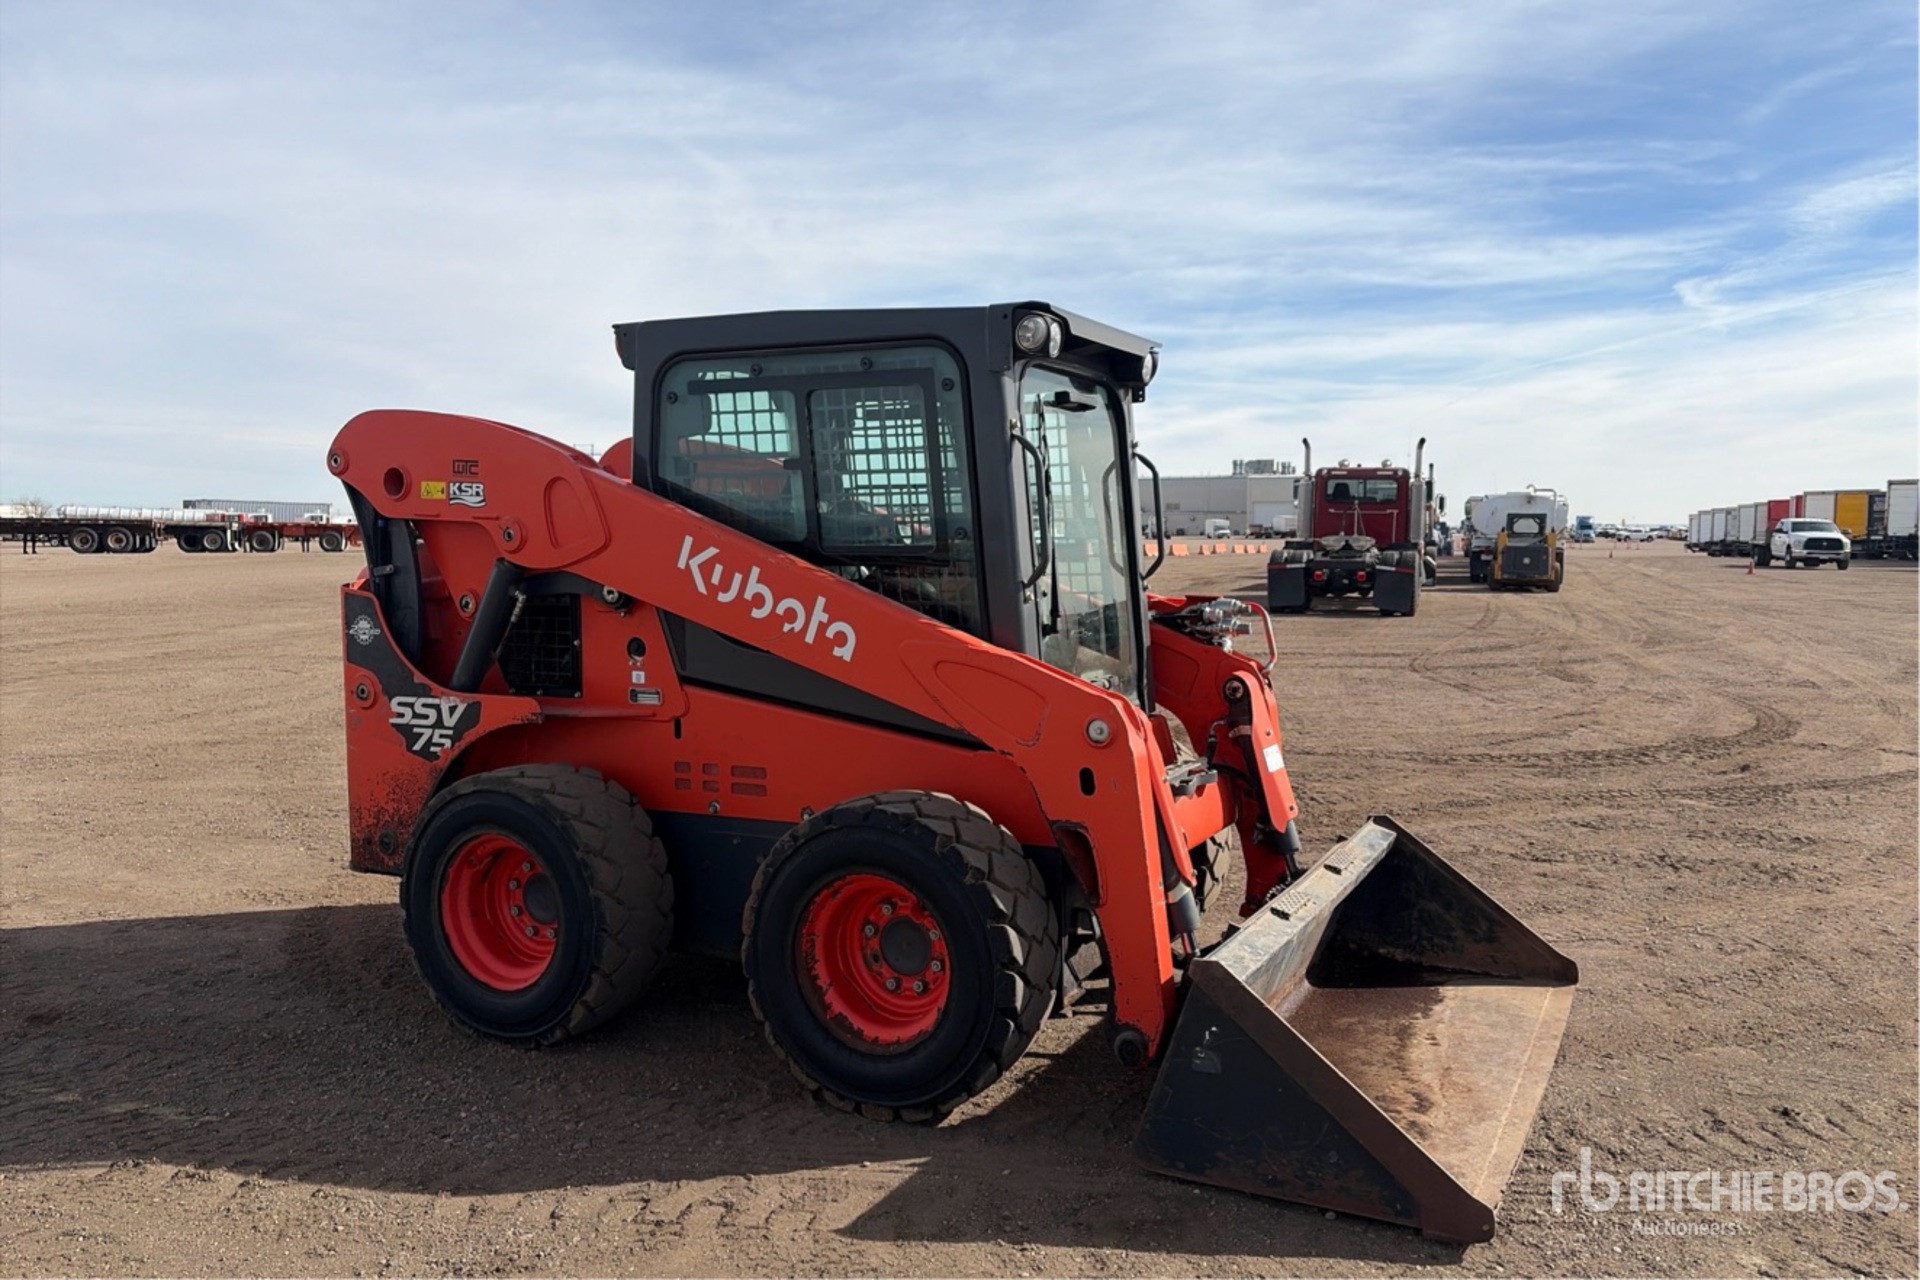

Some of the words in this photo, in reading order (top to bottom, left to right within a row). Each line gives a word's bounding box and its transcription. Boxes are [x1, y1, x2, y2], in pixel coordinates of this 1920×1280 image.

[449, 482, 484, 496] KSR
[677, 534, 857, 662] Kubota
[388, 695, 468, 728] SSV
[411, 727, 454, 754] 75
